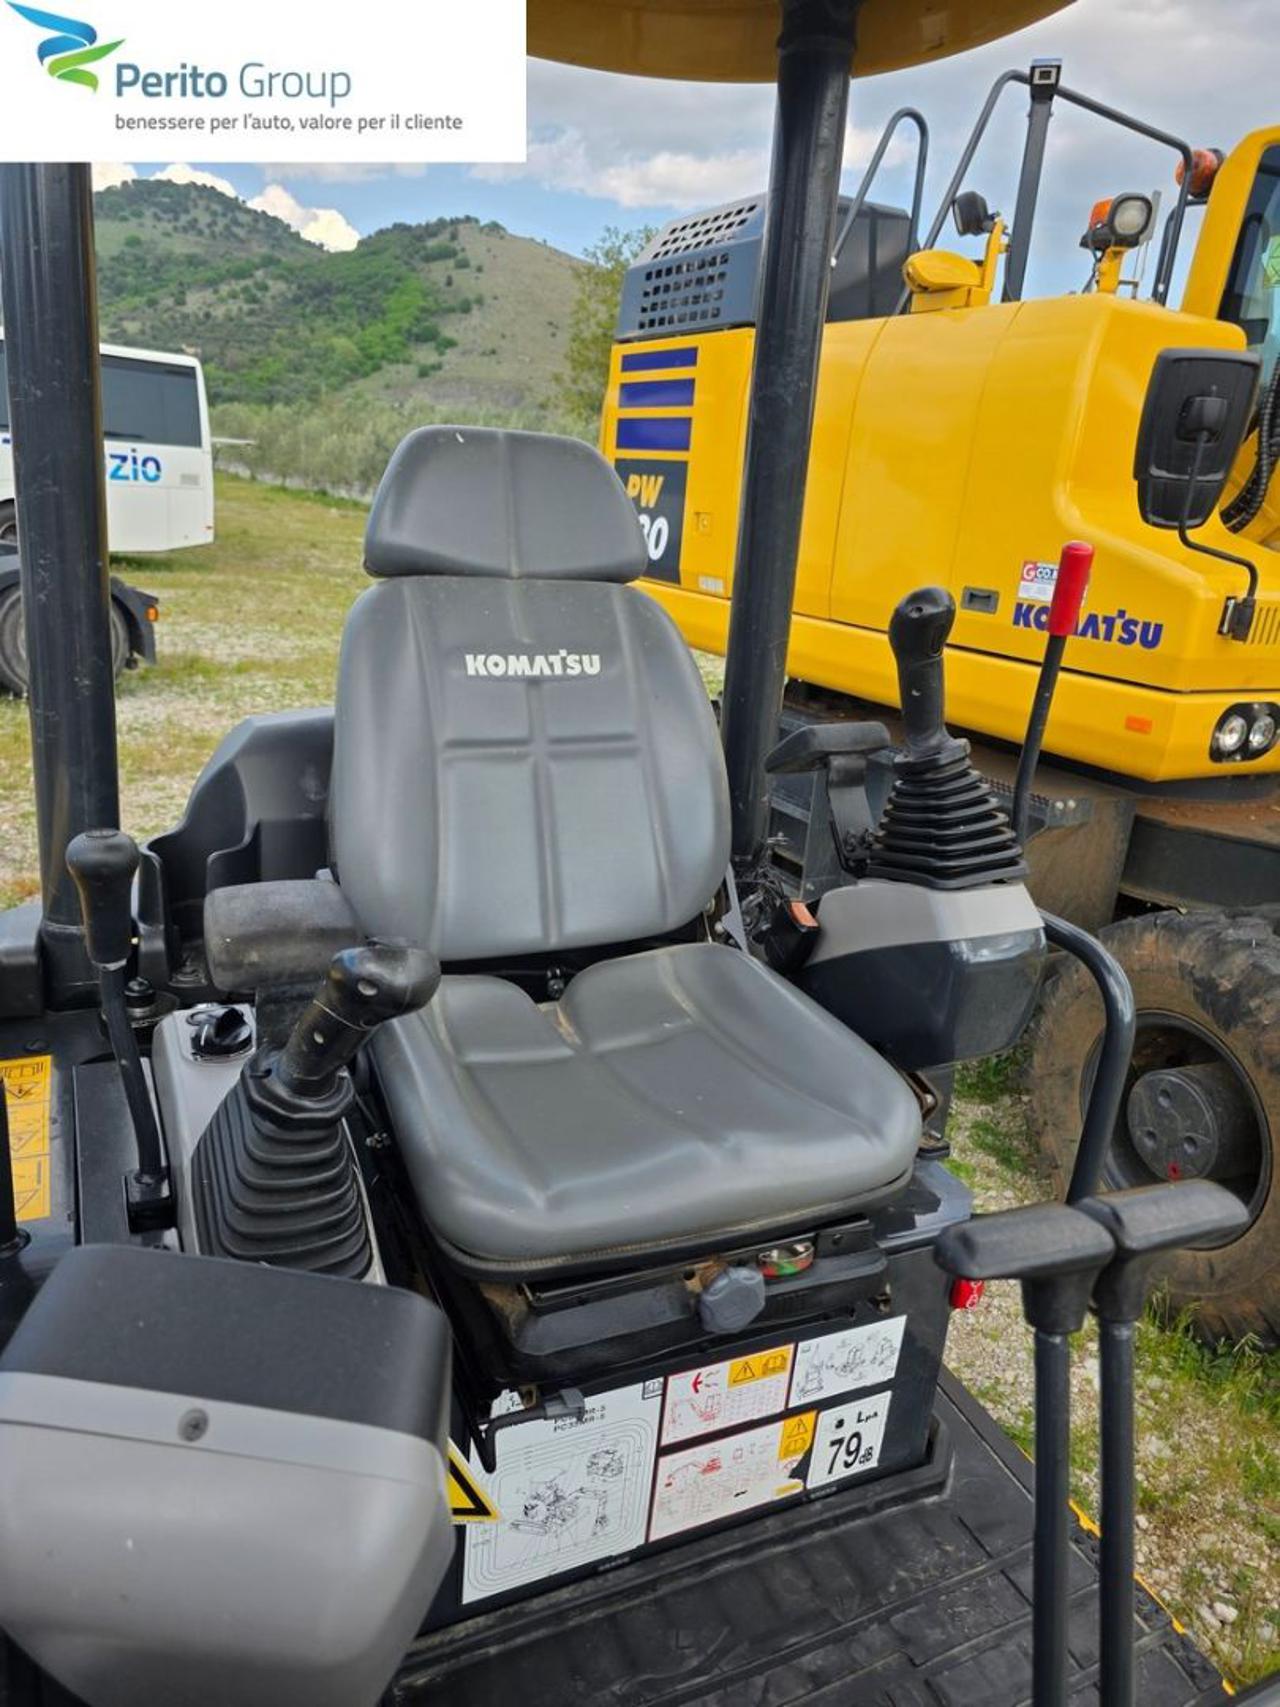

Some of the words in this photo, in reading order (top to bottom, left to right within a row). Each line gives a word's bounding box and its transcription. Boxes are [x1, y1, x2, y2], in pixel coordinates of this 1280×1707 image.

[108, 448, 162, 482] zio
[626, 473, 665, 509] PW
[1012, 602, 1164, 650] KOATSU
[465, 649, 601, 676] KOMATSU
[828, 1431, 862, 1475] 79
